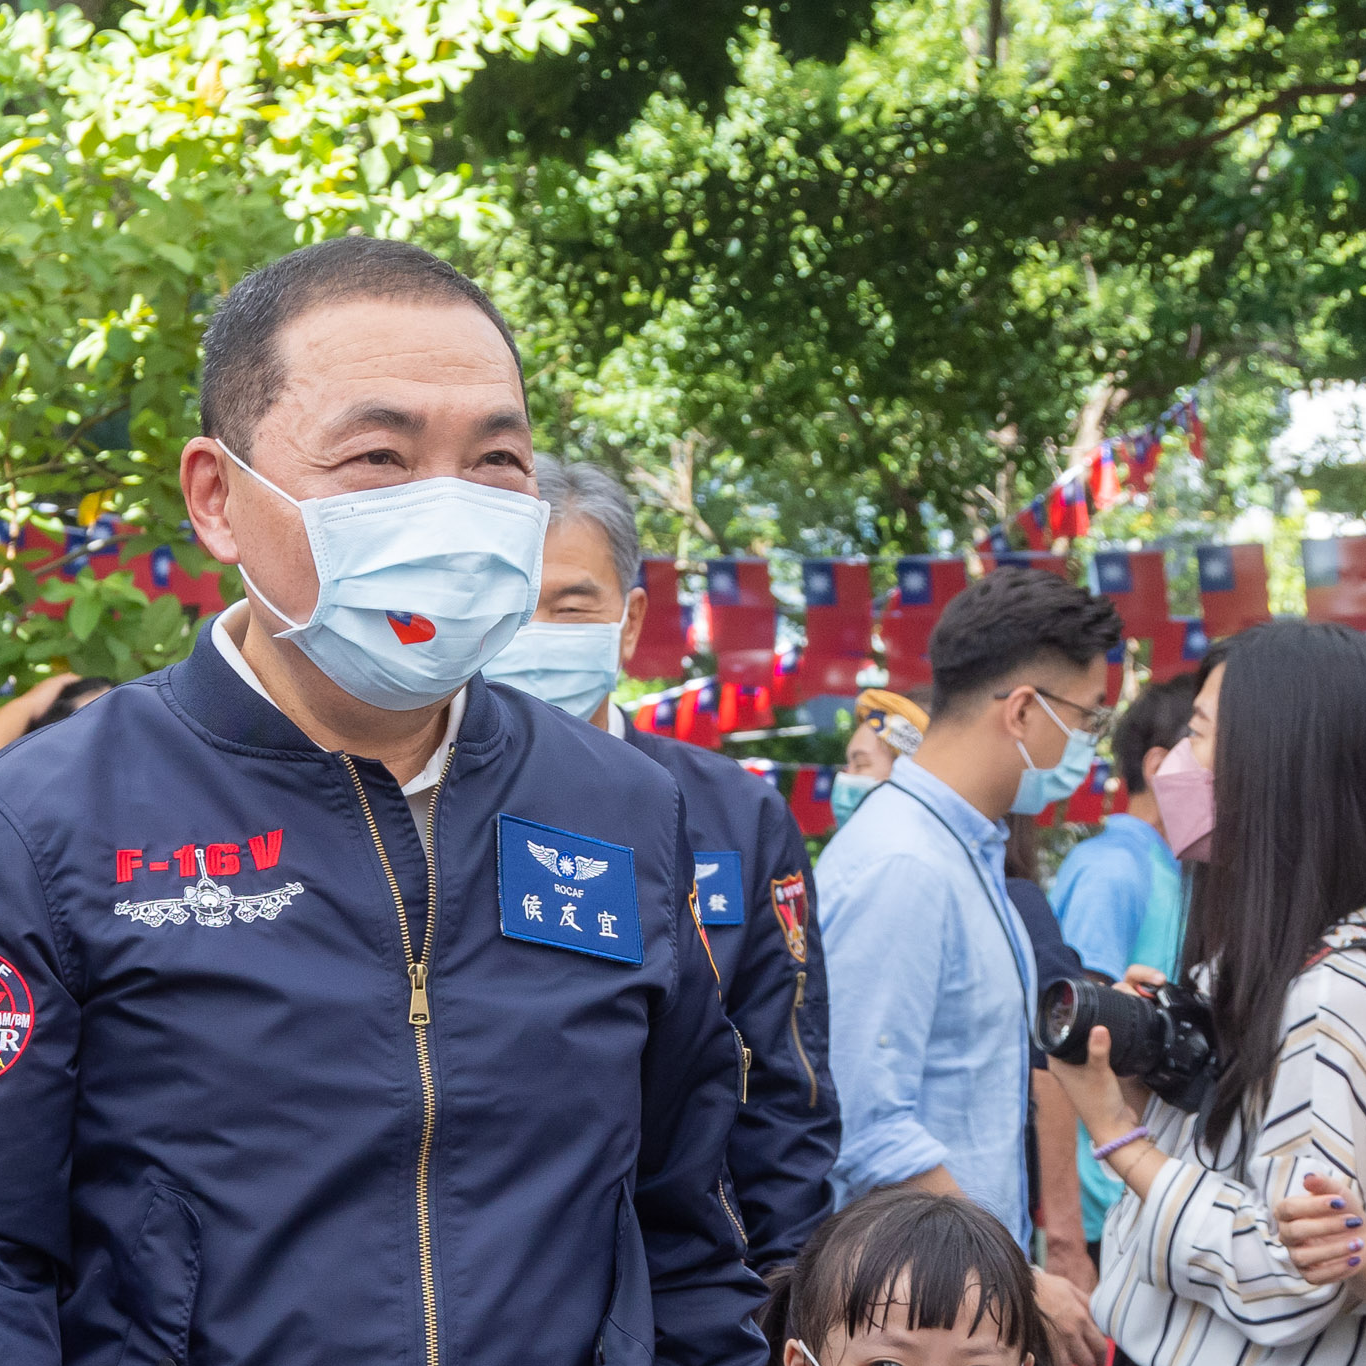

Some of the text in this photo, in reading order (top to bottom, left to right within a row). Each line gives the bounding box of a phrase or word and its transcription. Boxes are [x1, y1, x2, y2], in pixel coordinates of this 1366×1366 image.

[554, 883, 584, 898] ROCAF
[522, 894, 619, 938] 侯友宜
